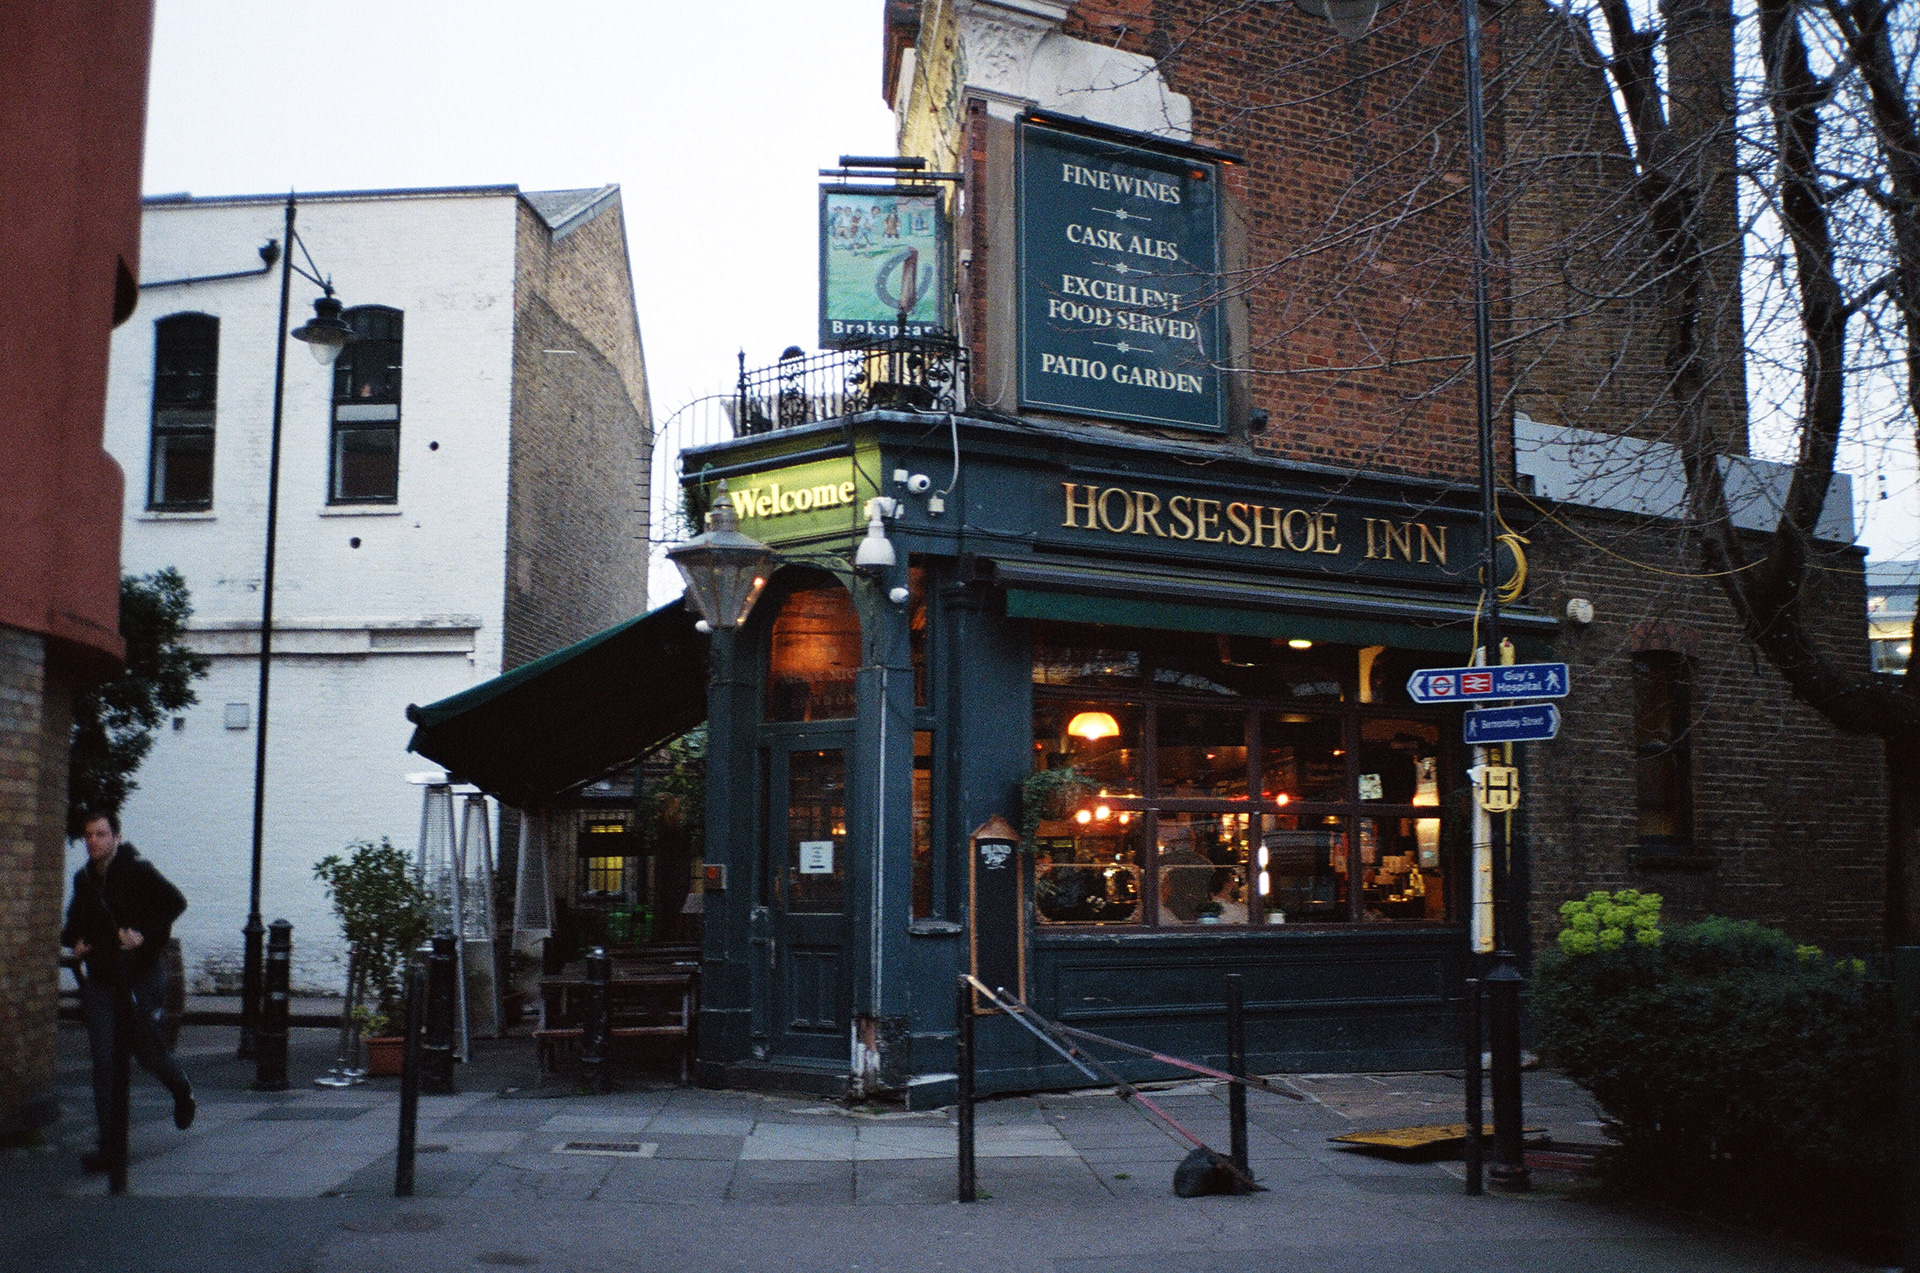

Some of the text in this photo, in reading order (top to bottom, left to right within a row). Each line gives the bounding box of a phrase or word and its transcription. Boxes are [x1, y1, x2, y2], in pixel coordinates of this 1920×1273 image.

[1062, 163, 1181, 205] FINE WINES
[1066, 224, 1179, 261] CASK ALES
[1062, 274, 1182, 312] EXCELLENT
[1049, 299, 1196, 340] FOOD SERVED
[1041, 353, 1203, 394] PATIO GARDEN
[730, 481, 856, 520] Welcome
[1061, 482, 1448, 566] HORSESHOE INN
[1496, 680, 1542, 695] Hospital
[1503, 670, 1536, 683] Guy's
